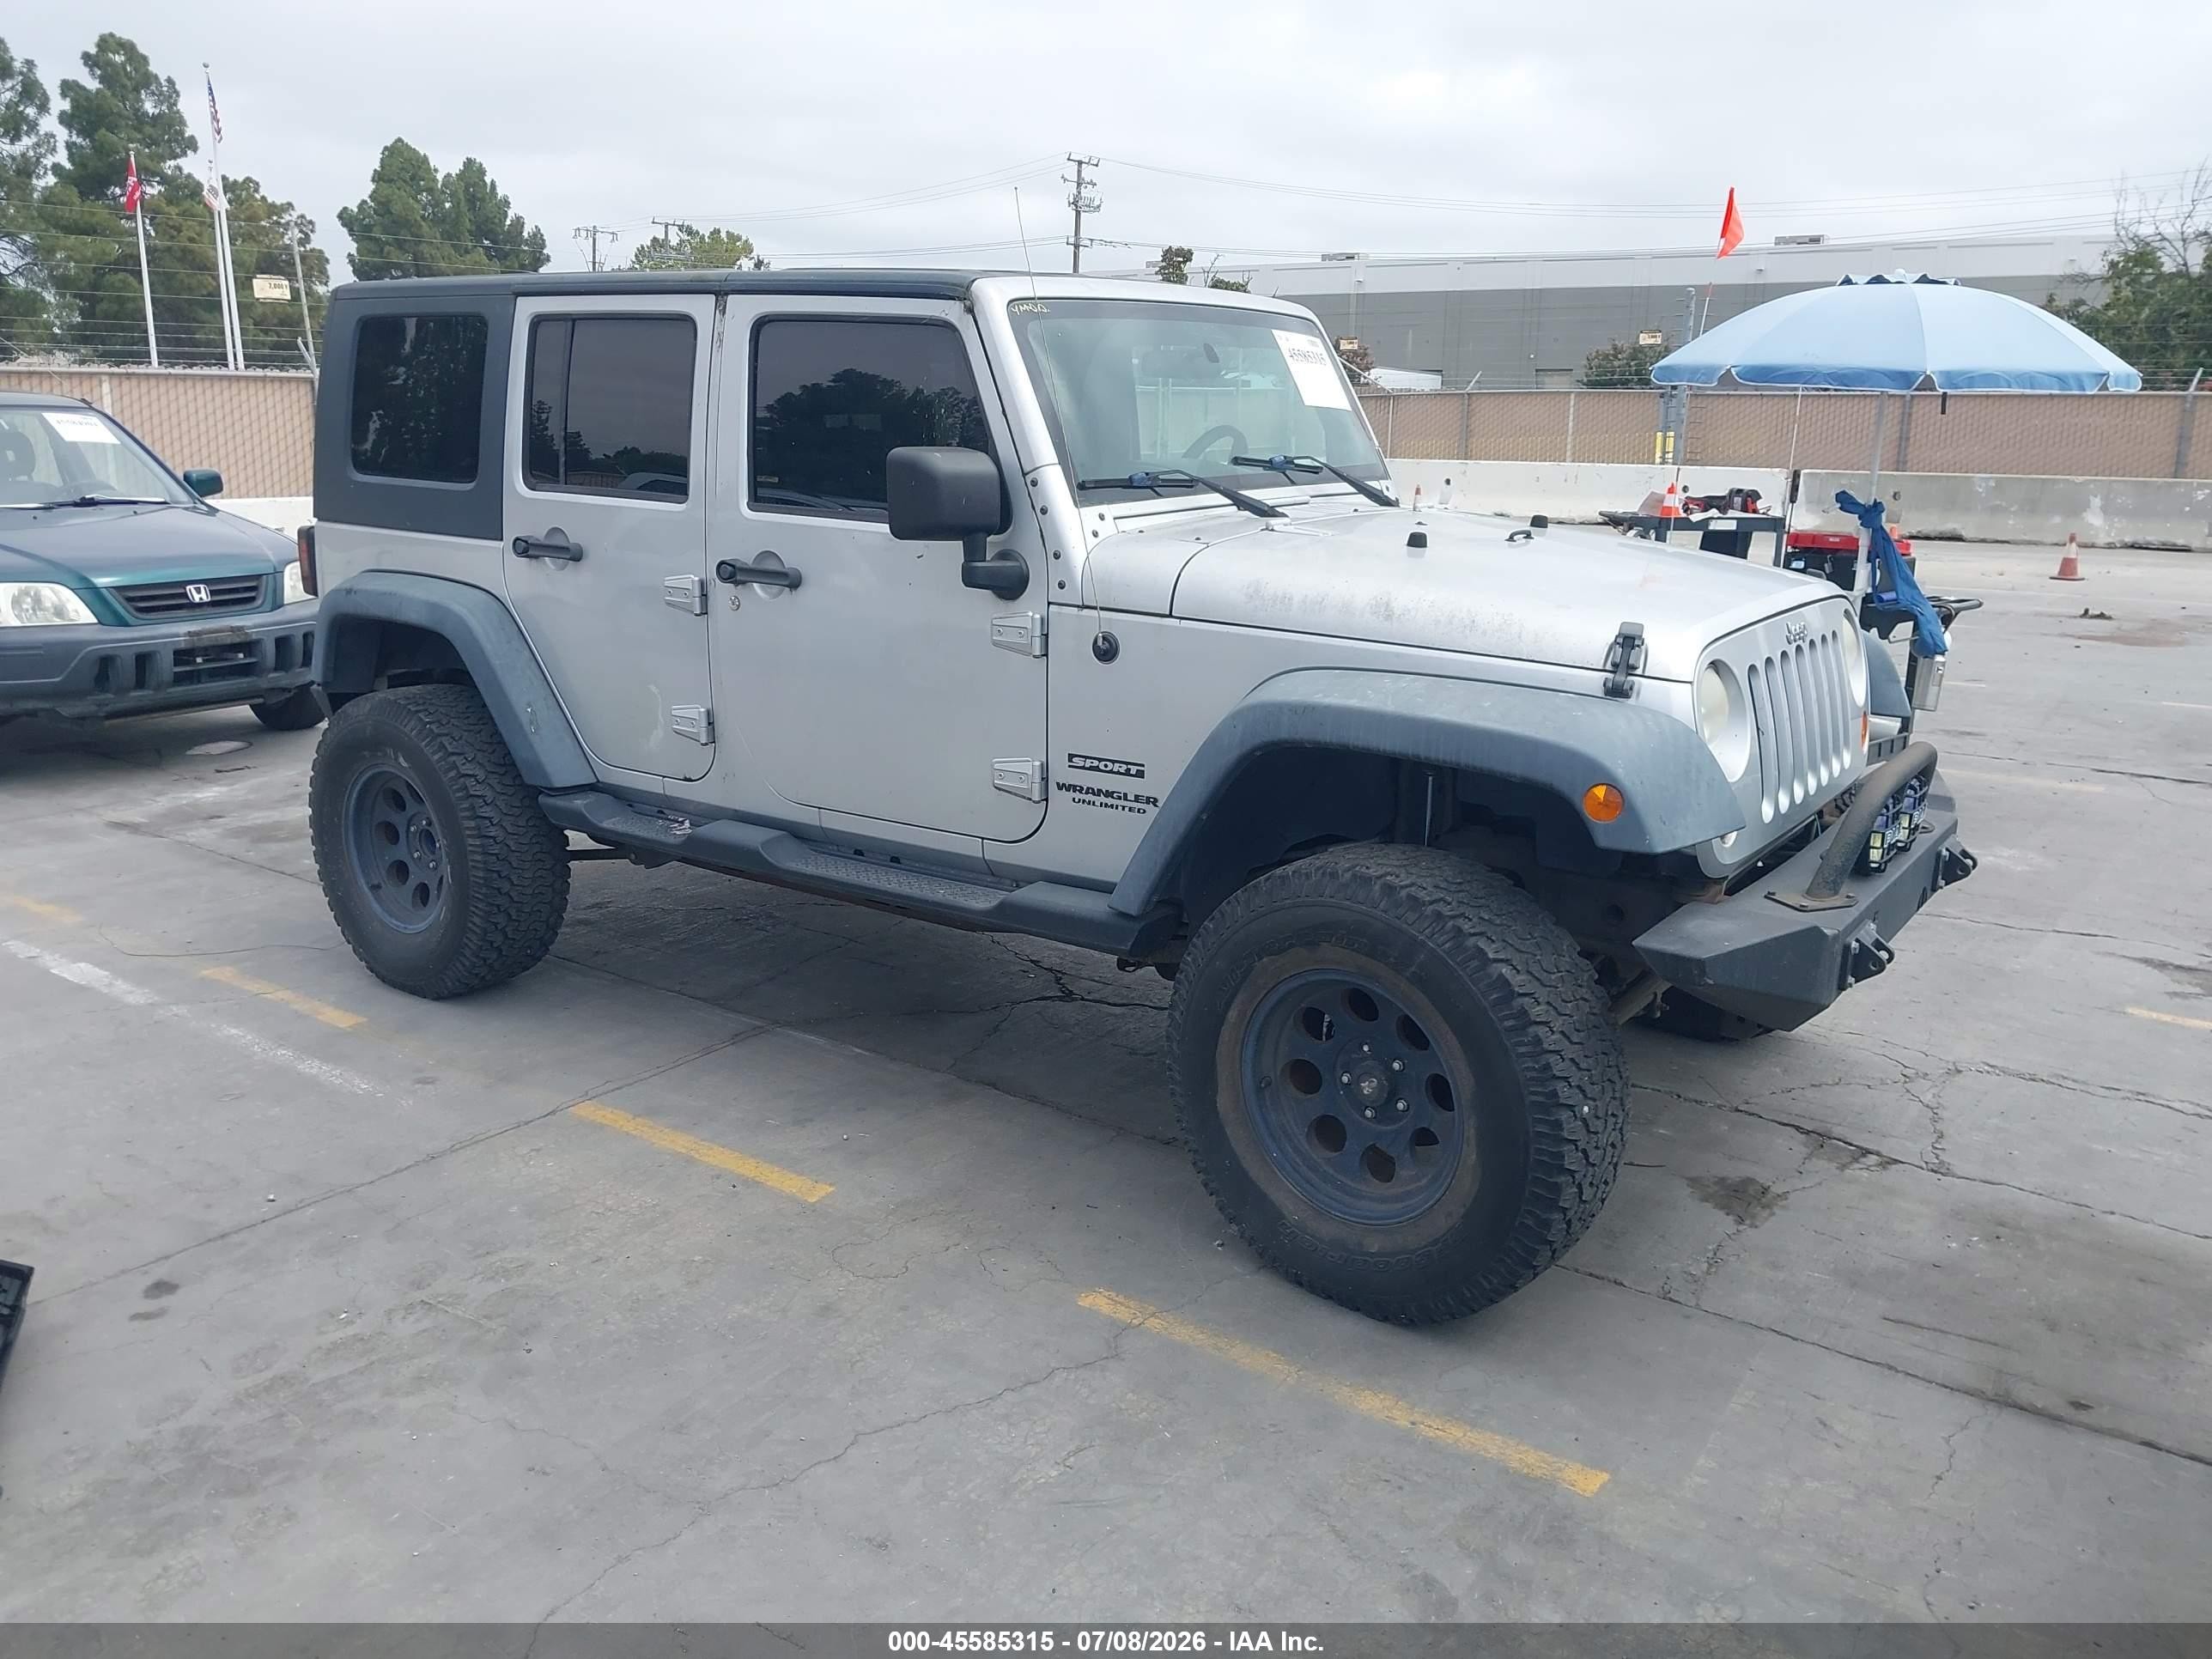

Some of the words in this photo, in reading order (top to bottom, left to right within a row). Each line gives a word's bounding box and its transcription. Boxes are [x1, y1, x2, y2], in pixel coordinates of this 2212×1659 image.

[1785, 622, 1808, 646] Jeep
[1072, 757, 1145, 775] SPORT
[1056, 782, 1159, 807] WRANGLER
[1072, 798, 1147, 815] UNLIMITED
